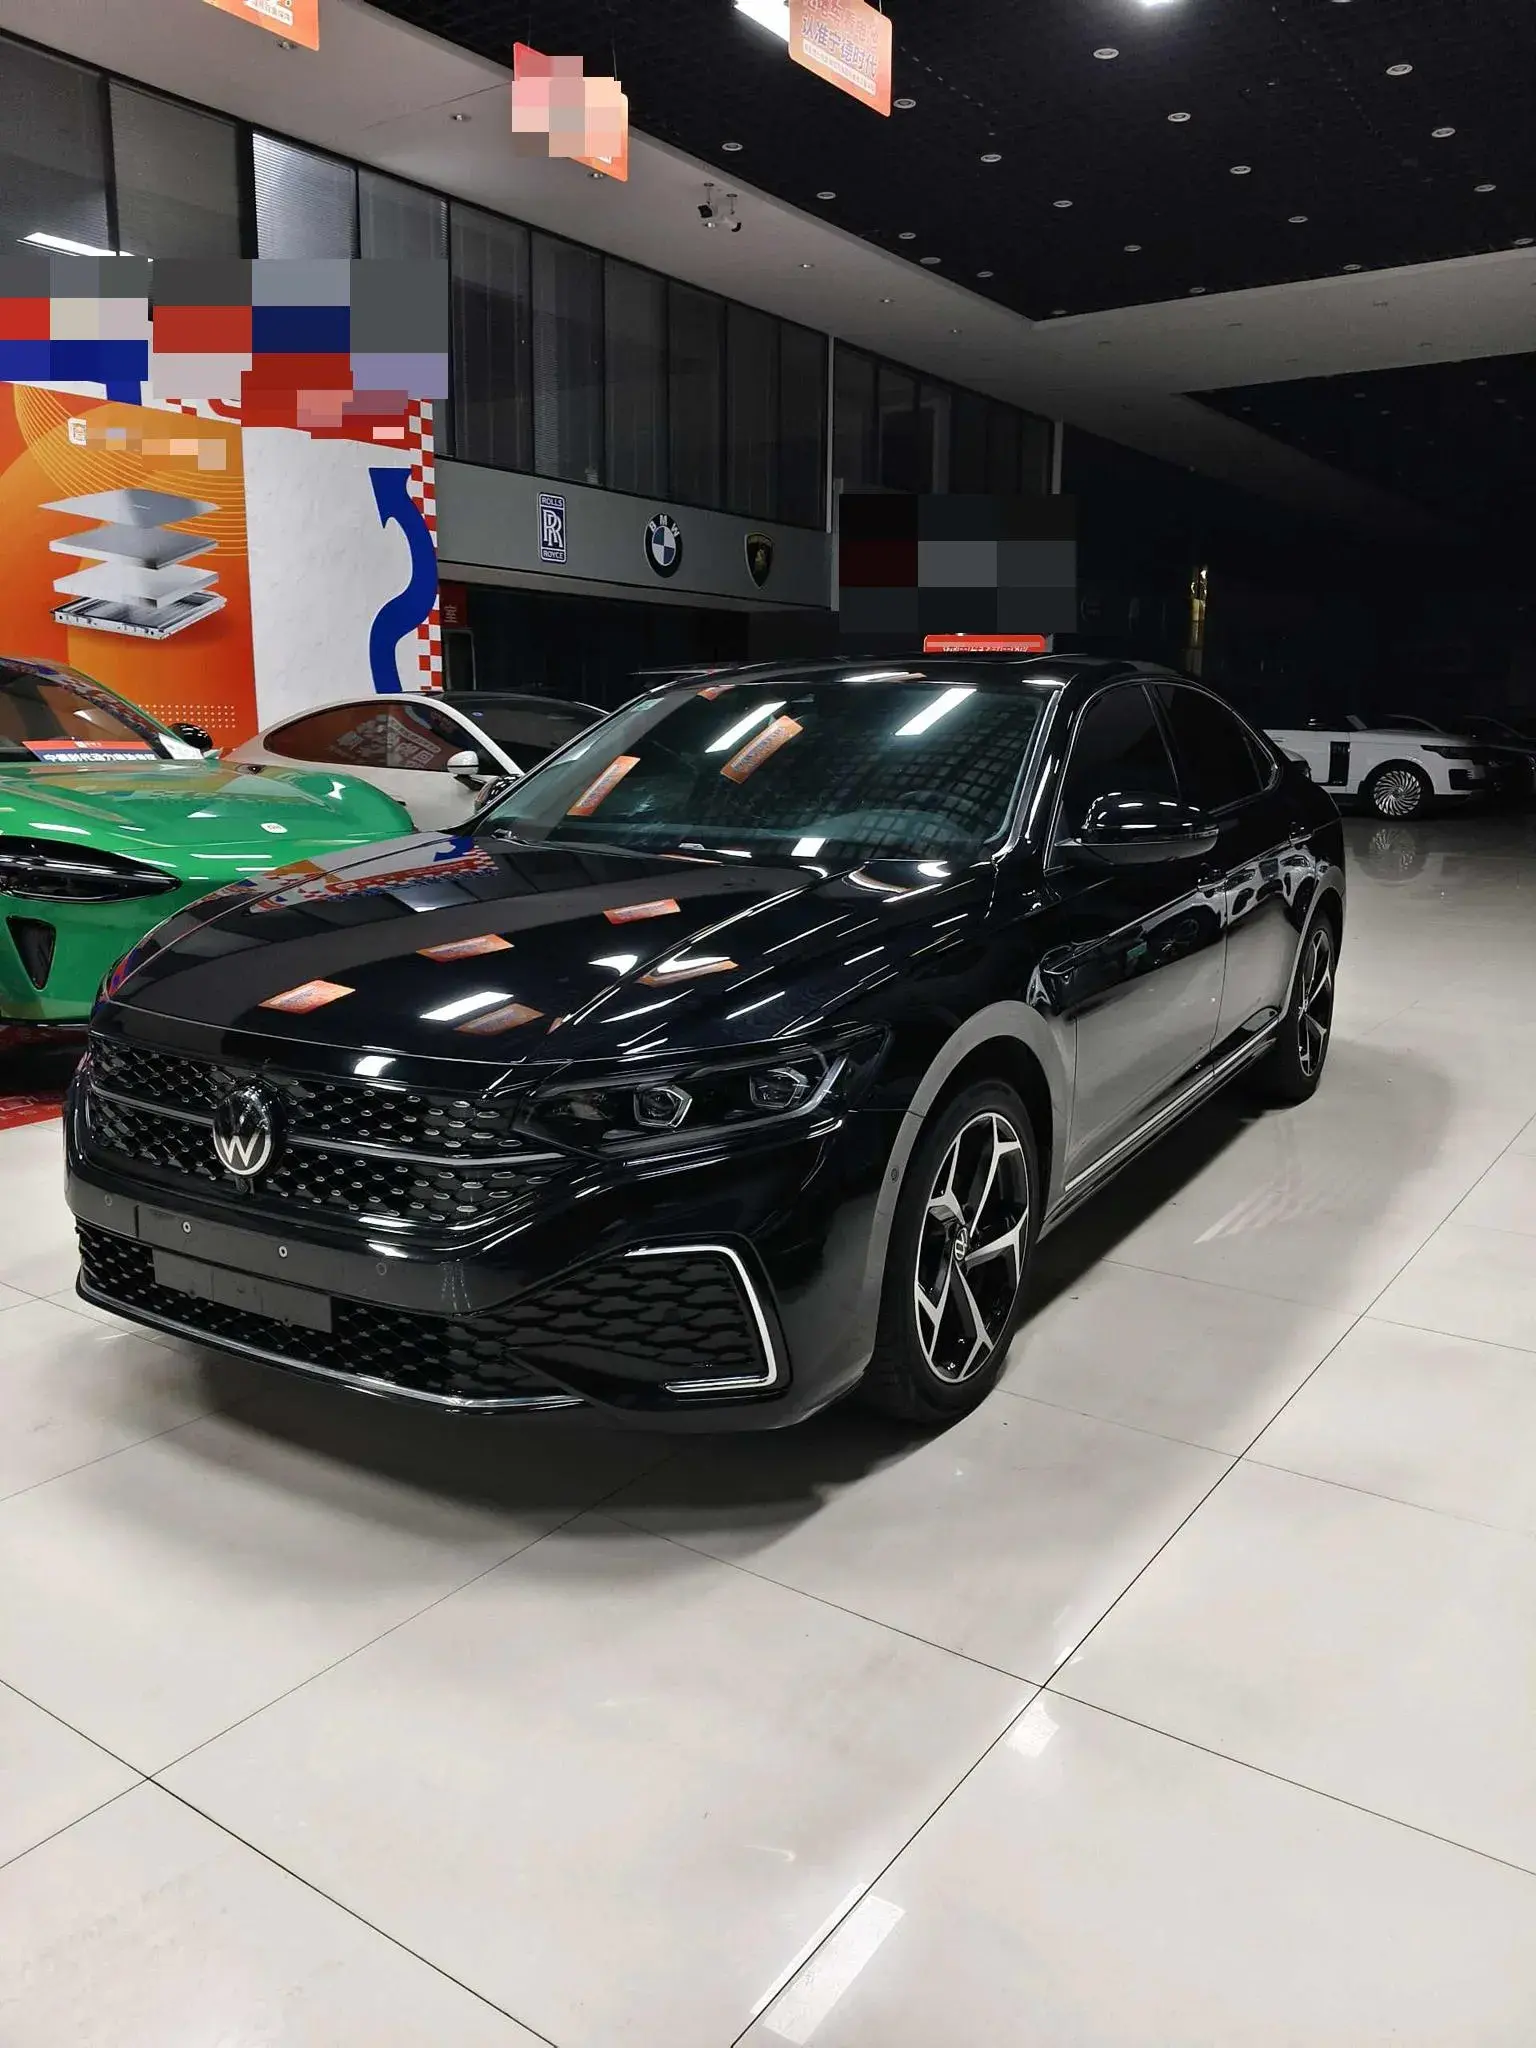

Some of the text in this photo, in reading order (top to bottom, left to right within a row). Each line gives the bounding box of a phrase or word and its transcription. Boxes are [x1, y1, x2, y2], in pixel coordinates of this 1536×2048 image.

[801, 14, 878, 79] 认准宁德时代
[541, 497, 563, 507] ROLLS
[649, 514, 680, 537] BMW
[543, 550, 563, 559] ROYCE
